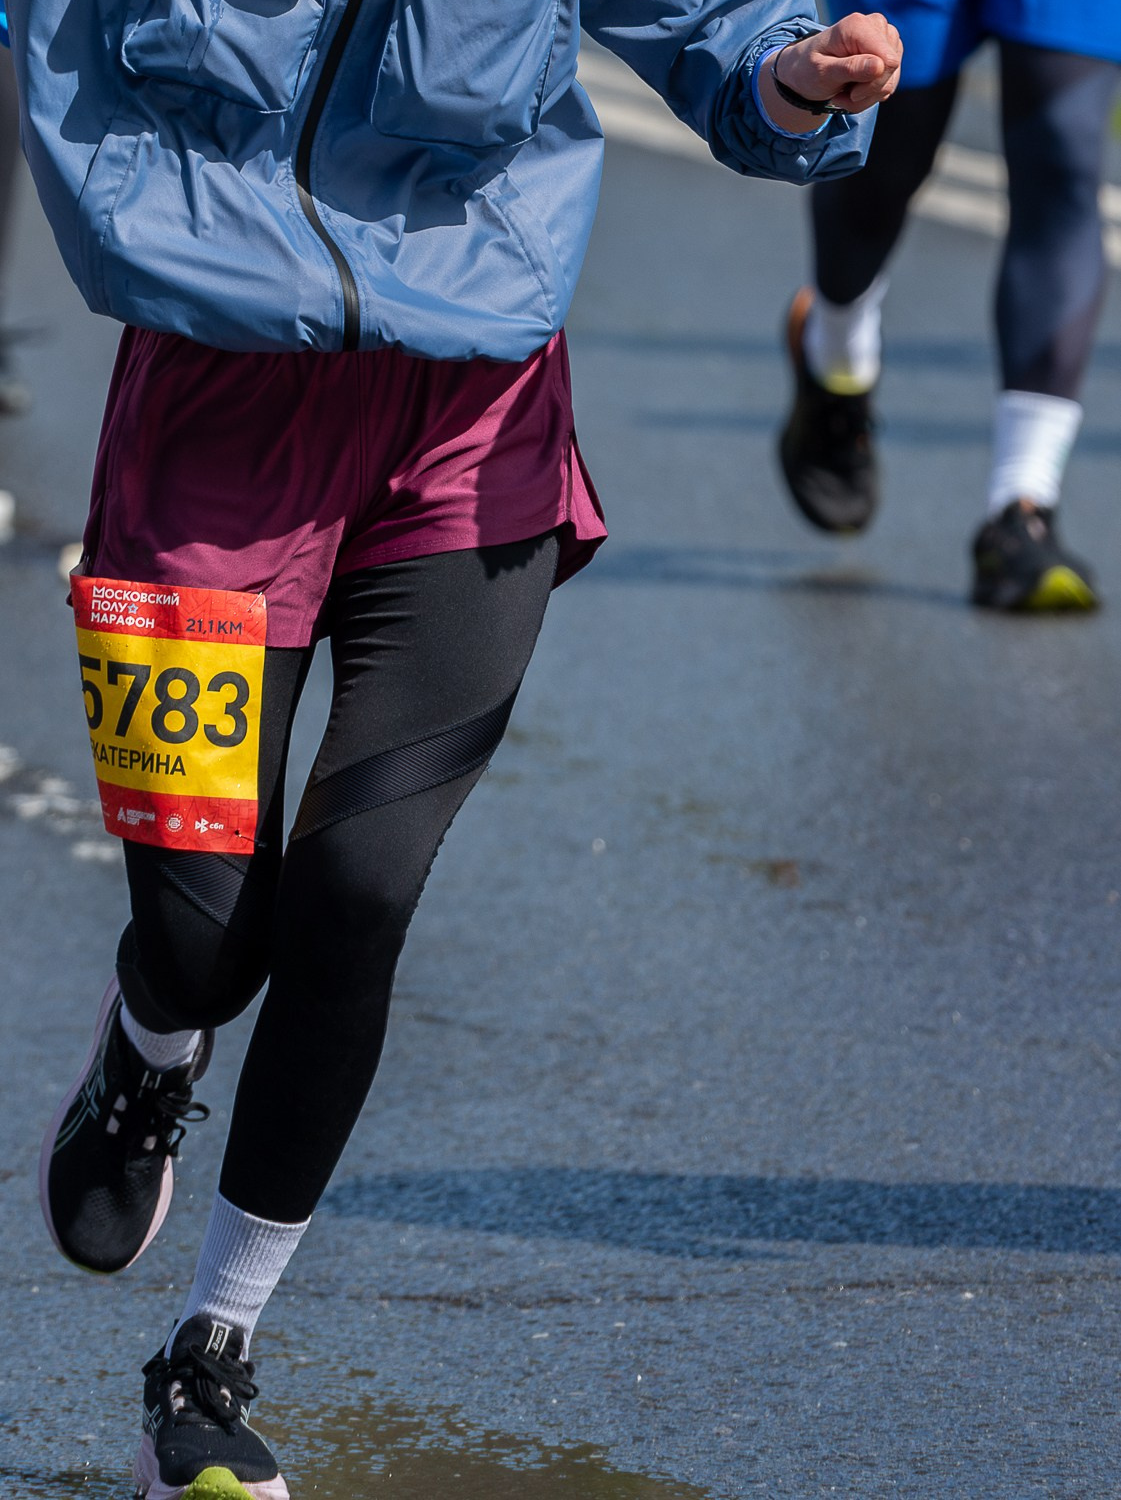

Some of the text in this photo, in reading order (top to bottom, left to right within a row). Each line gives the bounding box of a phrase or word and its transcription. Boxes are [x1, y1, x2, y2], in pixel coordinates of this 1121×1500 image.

[92, 585, 180, 606] МОСКОВСКИЙ
[91, 599, 128, 613] ПОЛУ
[90, 612, 155, 629] МАРАФОН
[90, 739, 187, 777] КАТЕРИНА
